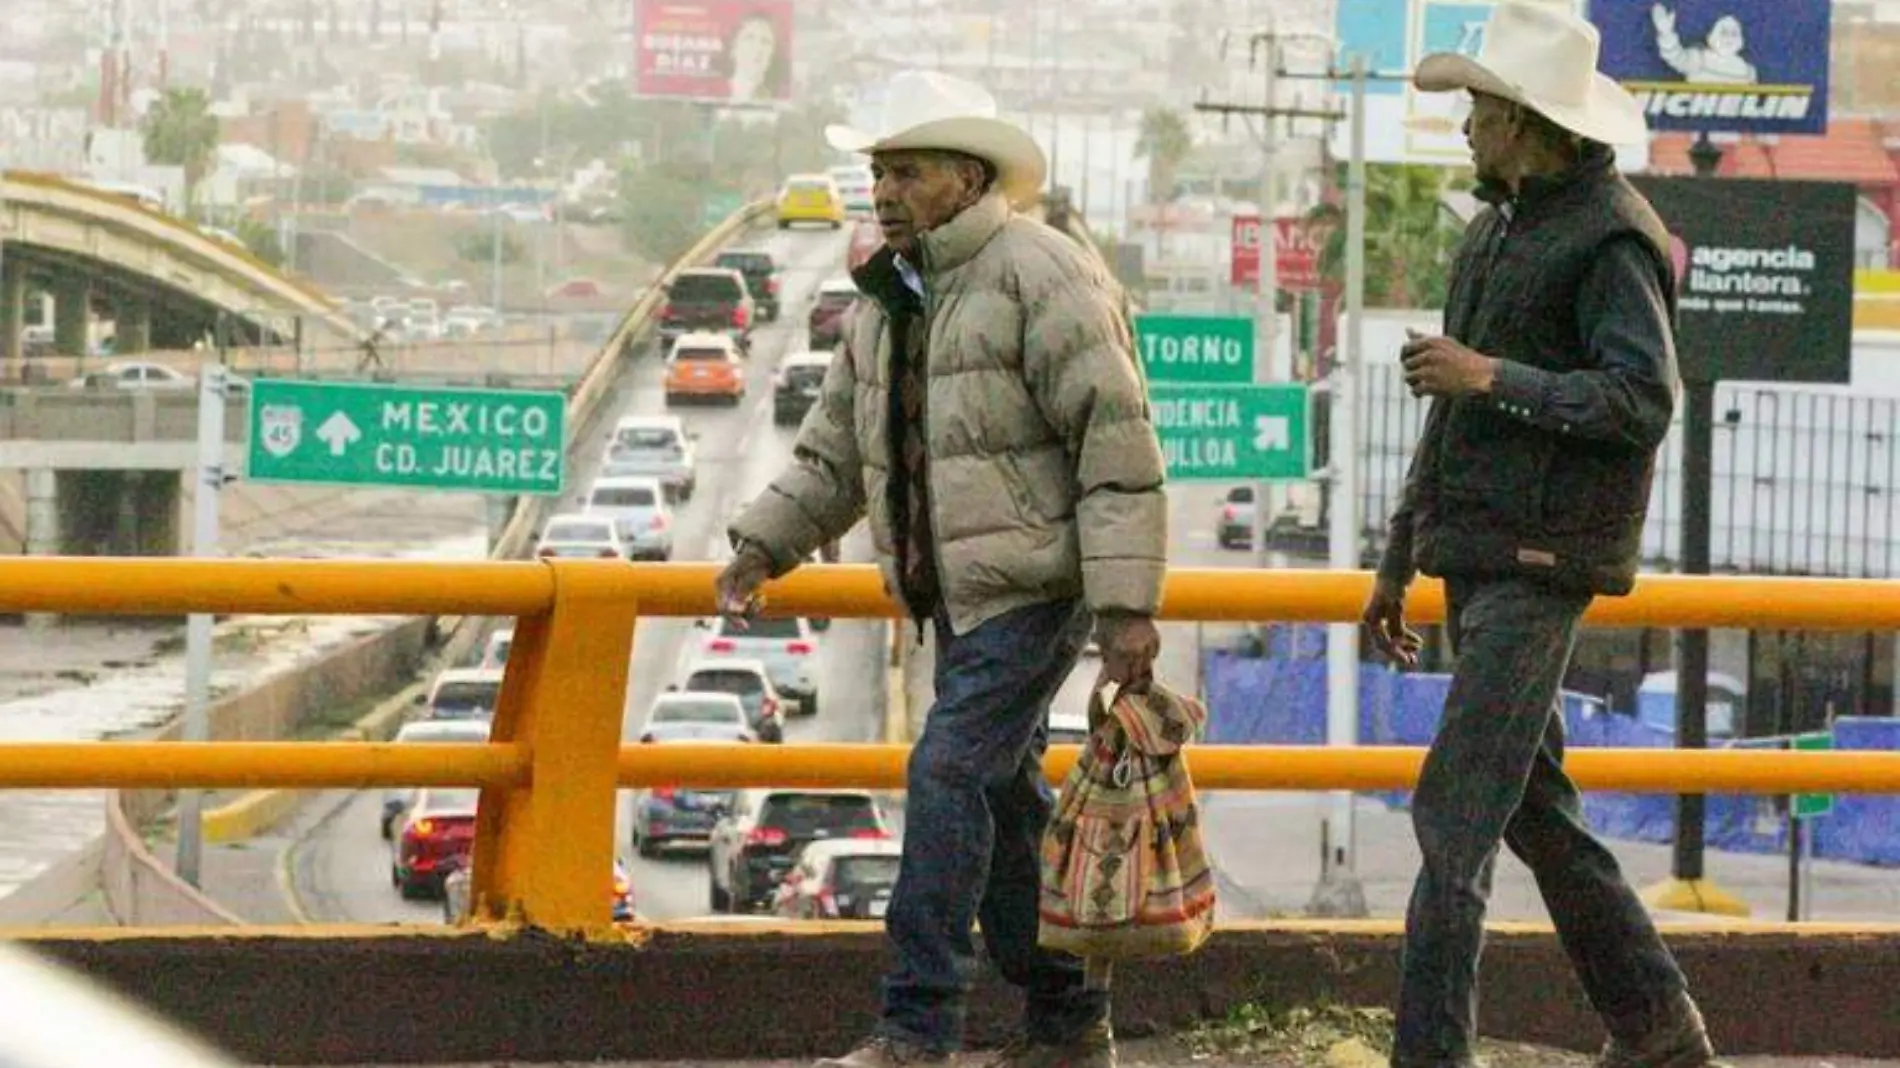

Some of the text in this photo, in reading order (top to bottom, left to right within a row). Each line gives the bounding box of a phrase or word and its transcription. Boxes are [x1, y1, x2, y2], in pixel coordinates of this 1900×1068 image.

[1692, 245, 1816, 272] agencia
[1142, 333, 1242, 365] TORNO
[381, 400, 548, 438] MEXICO
[268, 425, 293, 448] 45
[375, 442, 558, 481] CD. JUAREZ
